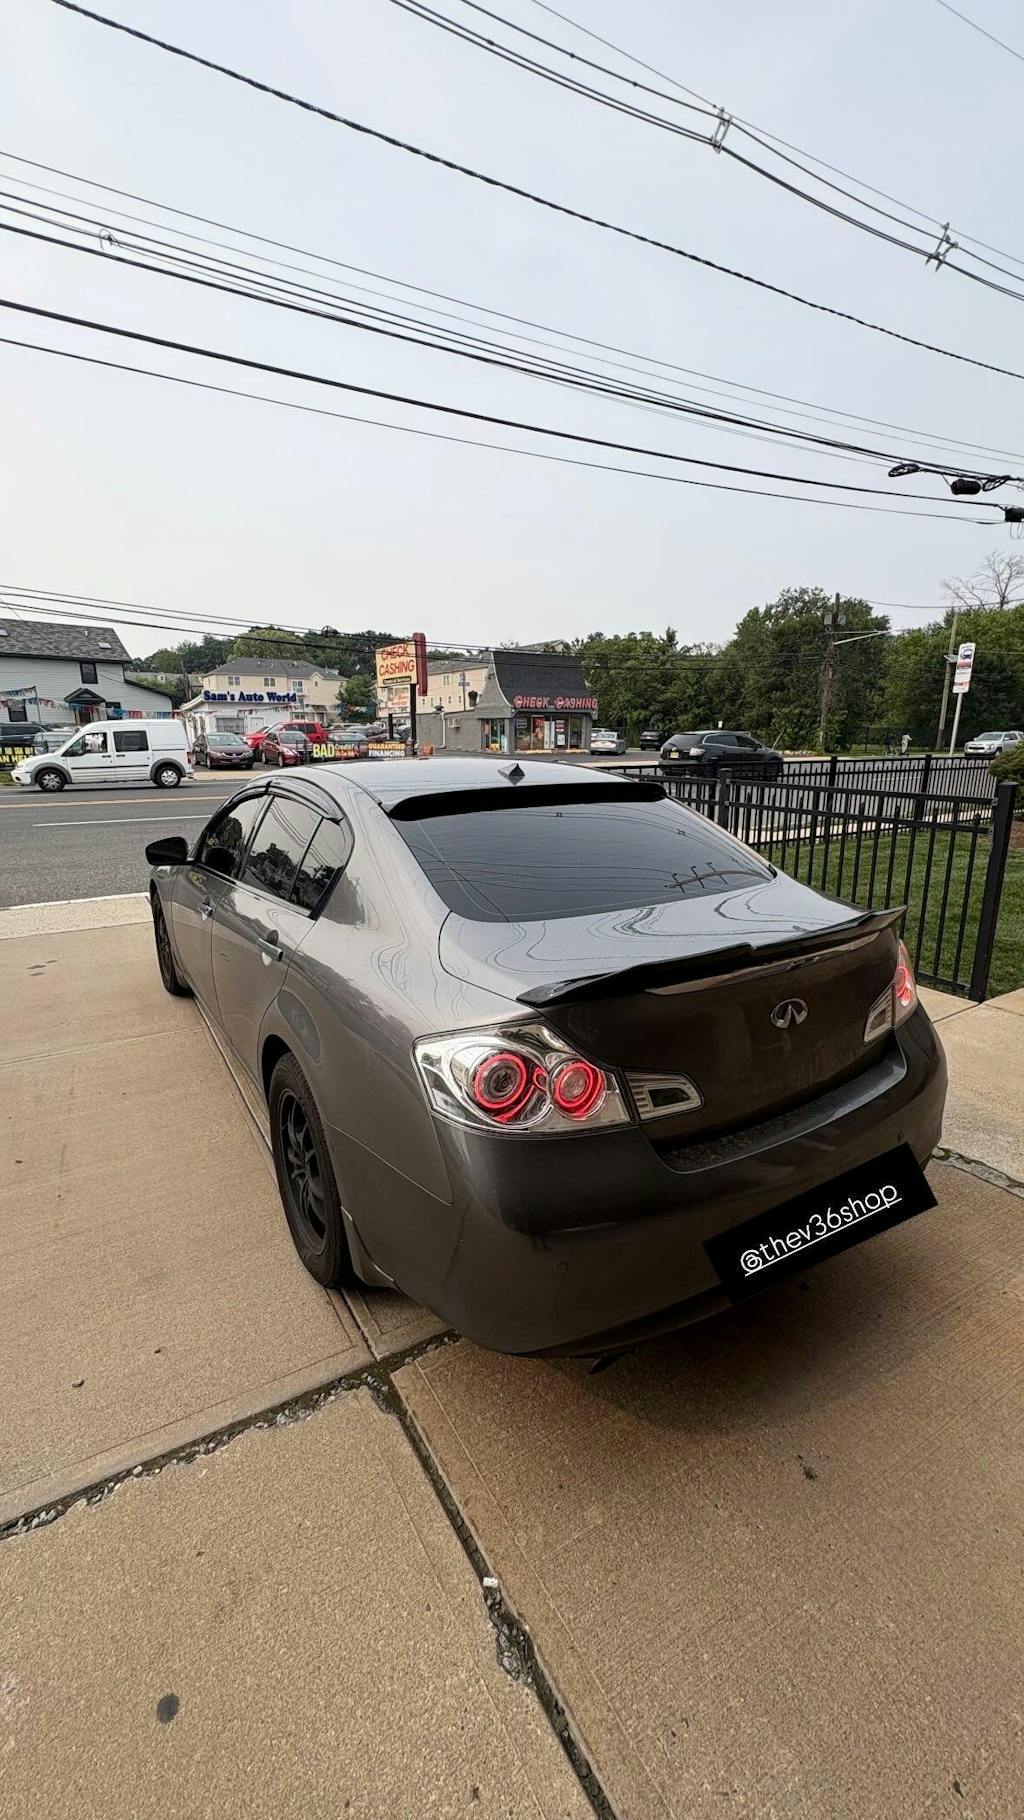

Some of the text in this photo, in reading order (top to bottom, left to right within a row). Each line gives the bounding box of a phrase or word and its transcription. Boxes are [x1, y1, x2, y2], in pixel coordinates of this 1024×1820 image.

[381, 645, 409, 660] CHECK
[379, 660, 415, 676] CASHING
[203, 690, 297, 702] Sam's Auto World
[514, 695, 598, 710] CHECK CASHING
[312, 743, 335, 758] BAD
